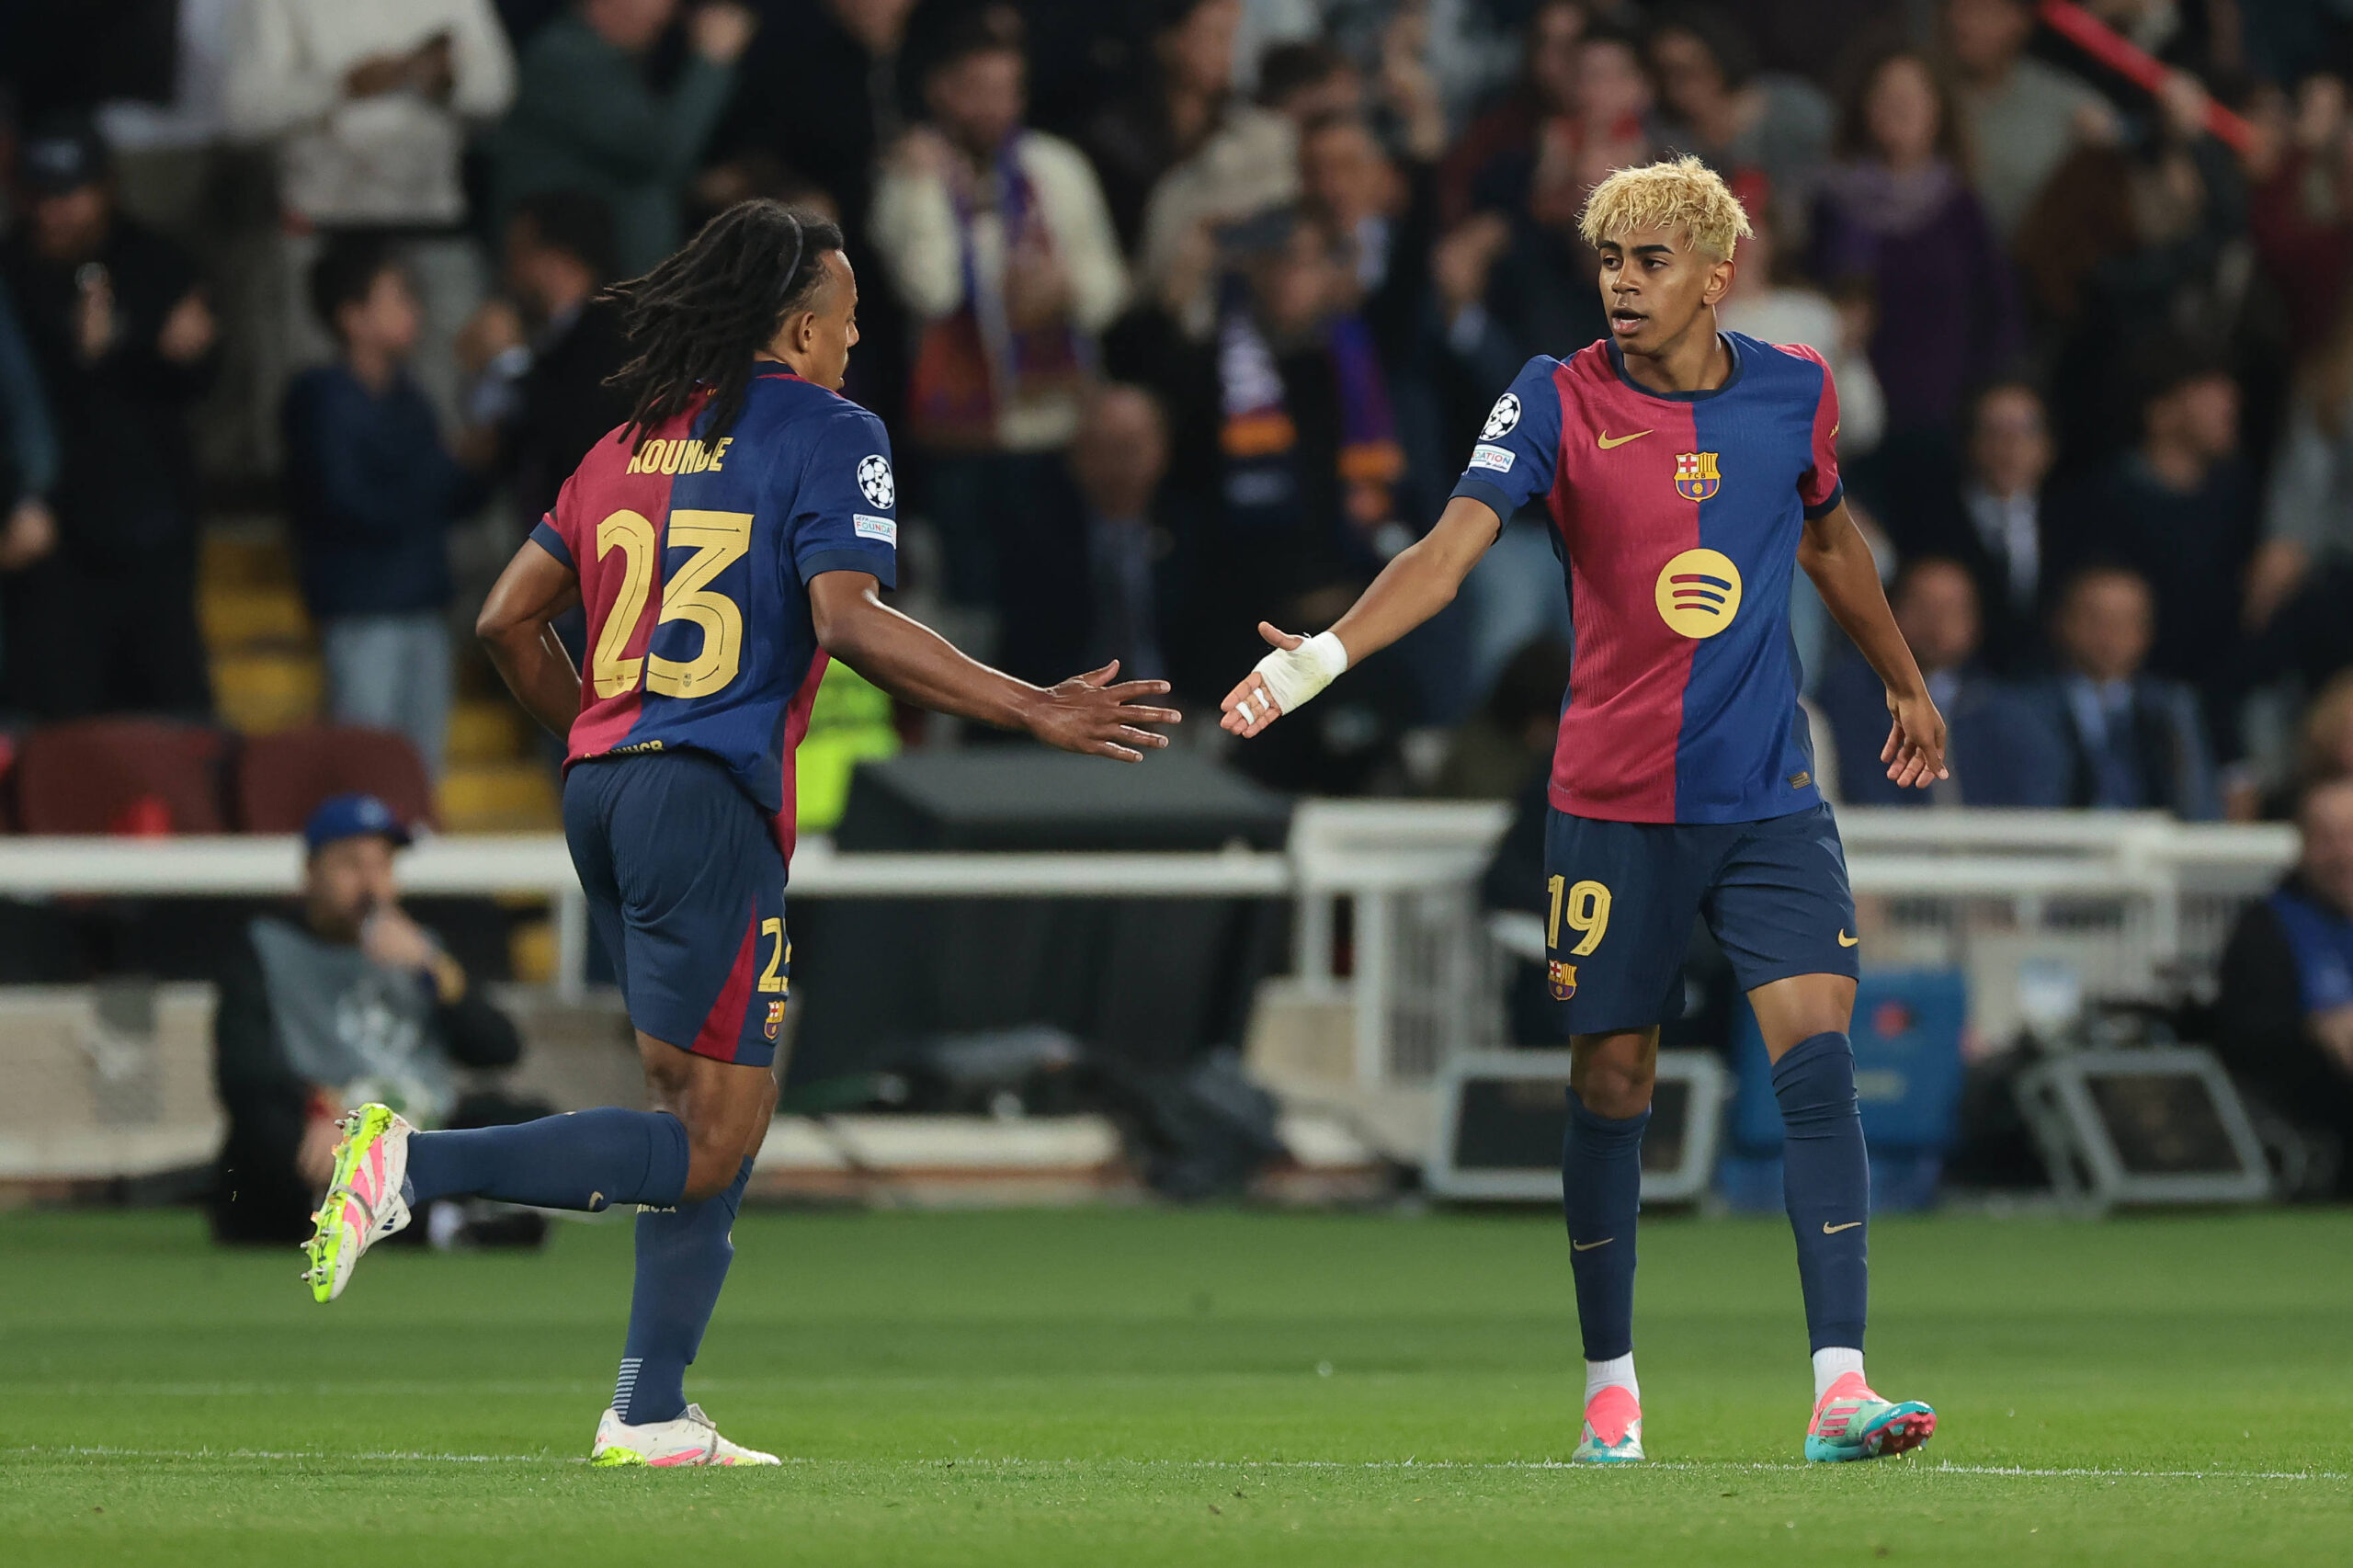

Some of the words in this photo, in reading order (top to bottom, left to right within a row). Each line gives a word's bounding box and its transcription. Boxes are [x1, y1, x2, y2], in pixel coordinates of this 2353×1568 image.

[1471, 451, 1511, 465] DATION
[593, 509, 755, 699] 23
[1548, 874, 1612, 956] 19
